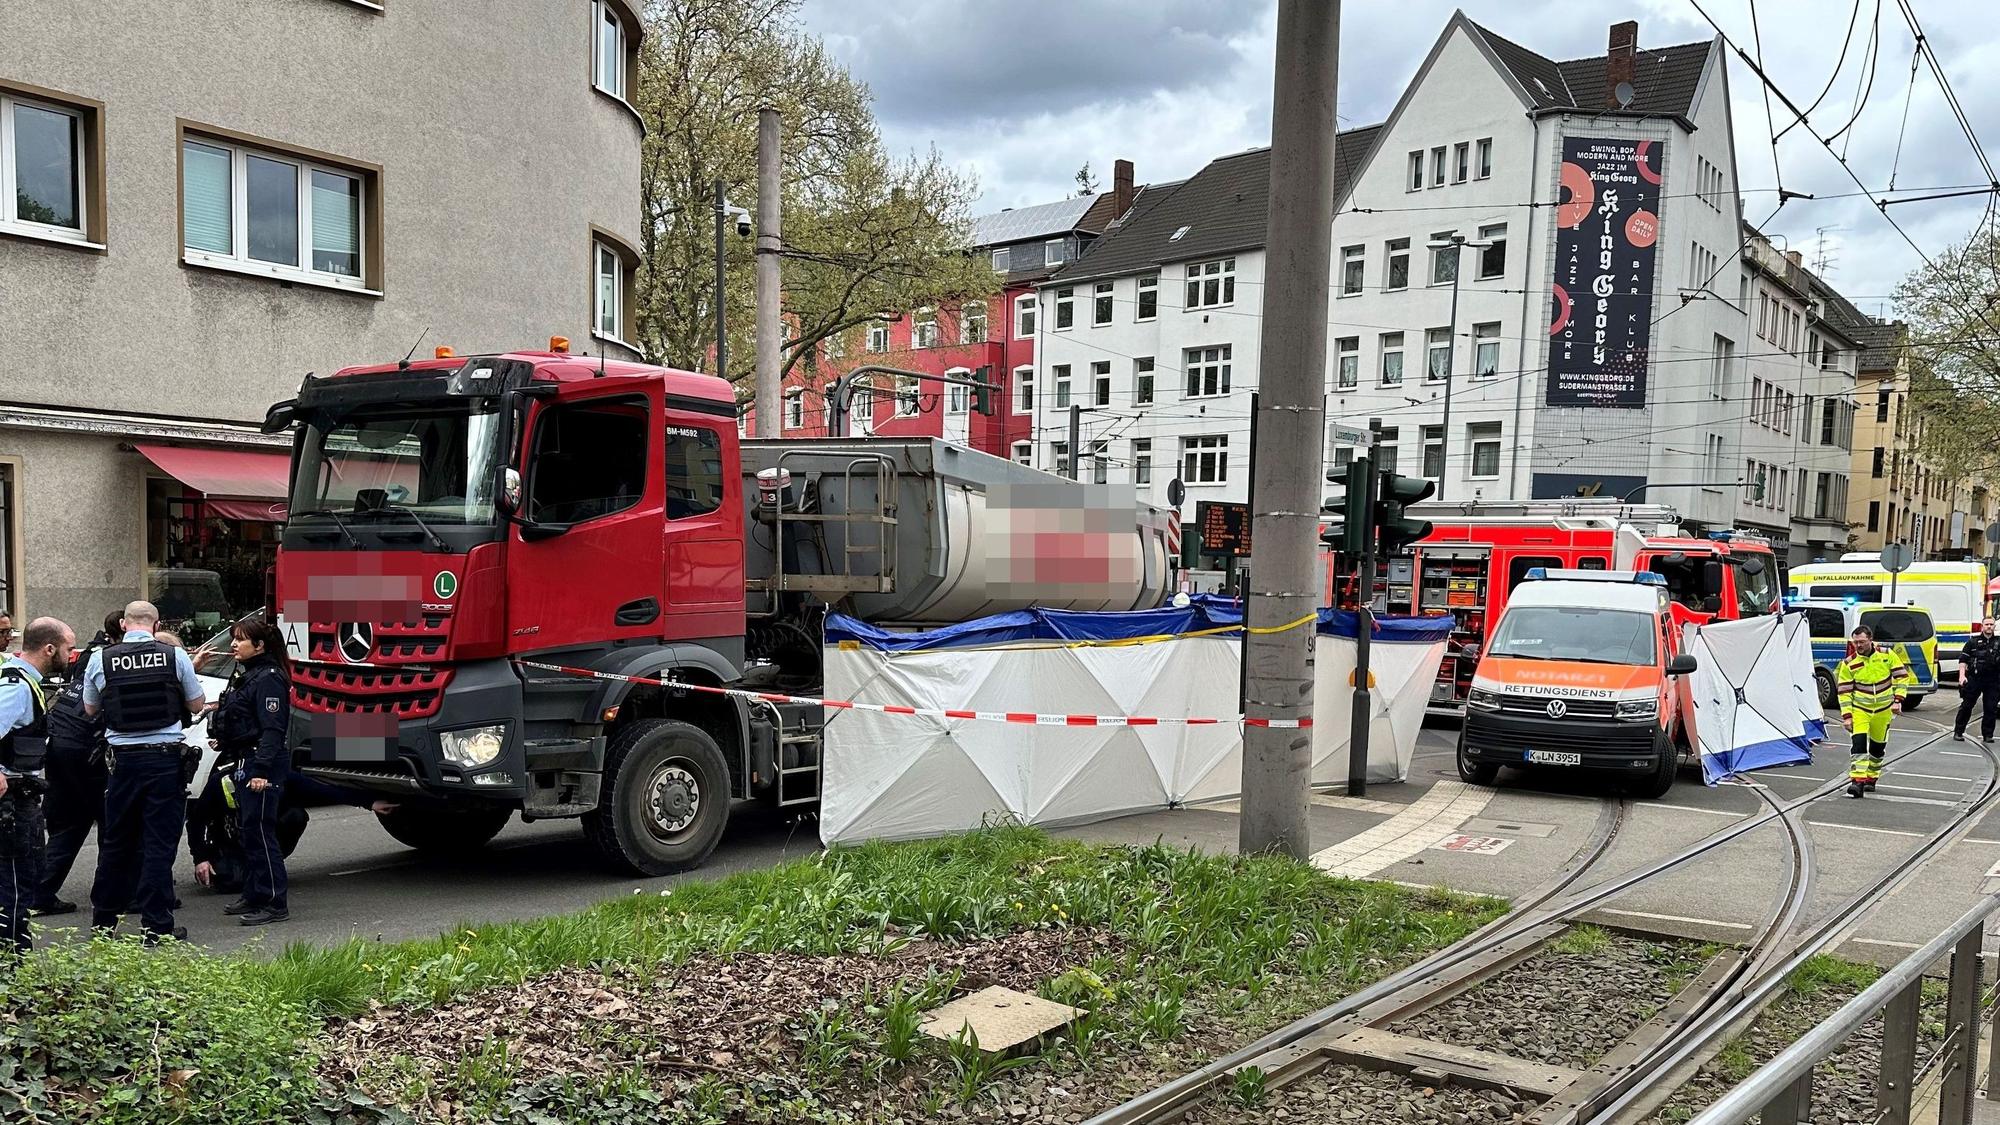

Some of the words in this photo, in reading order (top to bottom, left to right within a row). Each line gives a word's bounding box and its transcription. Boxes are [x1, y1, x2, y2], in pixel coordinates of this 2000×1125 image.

[1591, 145, 1618, 153] SWING,
[1577, 152, 1608, 160] MODERN
[1627, 154, 1649, 162] MORE
[1597, 163, 1616, 171] JAZZ
[1589, 171, 1610, 183] King
[1610, 173, 1638, 184] Georg
[1631, 225, 1652, 238] DAILY
[1634, 219, 1654, 232] OPEN
[1630, 260, 1640, 295] BAR
[1564, 320, 1575, 360] MORE
[1559, 373, 1635, 382] WWW.KINGGEORG.DE
[1558, 383, 1627, 391] SUDERMANSTRASSE
[666, 427, 698, 438] BM-M592
[440, 577, 450, 593] L
[421, 603, 453, 611] ROCS
[286, 623, 301, 653] A
[111, 652, 168, 672] POLIZEI
[1515, 670, 1608, 683] NOTARZT
[1504, 684, 1615, 698] RETTUNGSDIENST
[1529, 751, 1536, 760] K
[1541, 752, 1555, 762] LN
[1556, 753, 1580, 763] 3951
